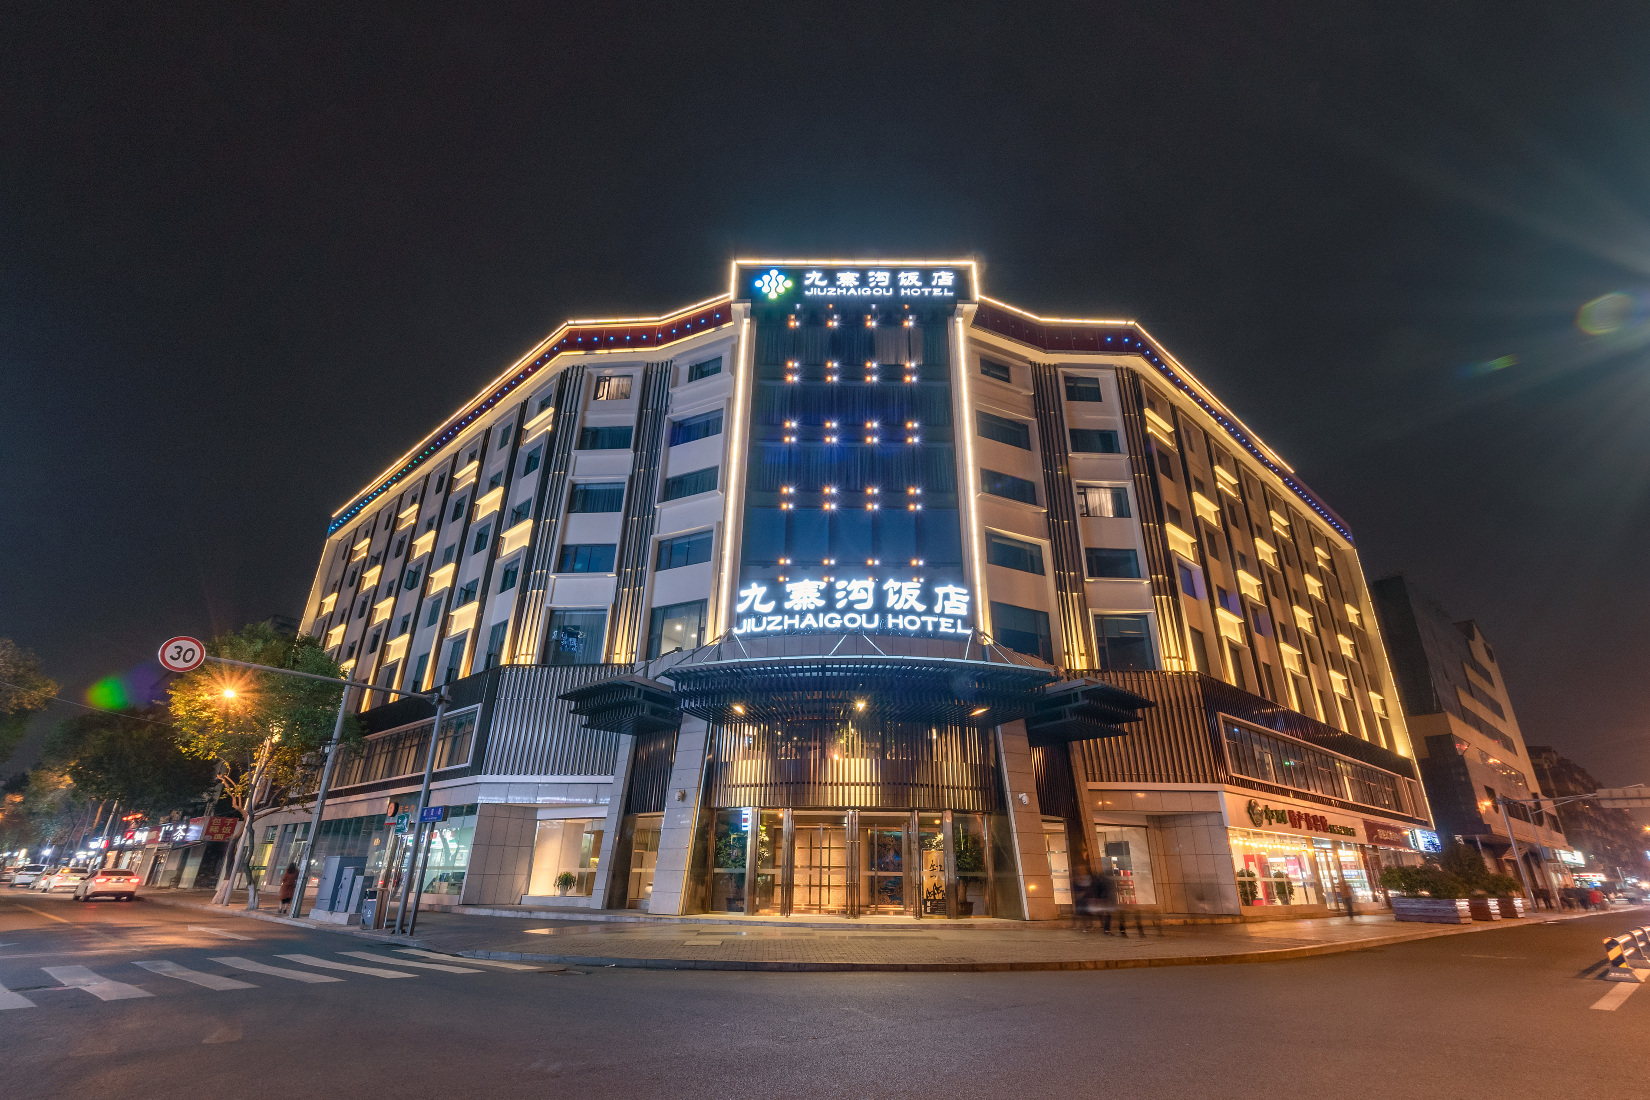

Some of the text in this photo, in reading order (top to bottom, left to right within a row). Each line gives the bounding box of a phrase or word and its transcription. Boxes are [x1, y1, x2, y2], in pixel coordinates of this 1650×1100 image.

[804, 271, 954, 287] 九寨沟饭店
[804, 287, 954, 297] JIUZHAIGOU HOTEL
[736, 579, 970, 615] 九寨沟饭店
[733, 614, 972, 634] JIUZHAIGOU HOTEL
[169, 645, 195, 664] 30
[212, 818, 234, 826] 包子
